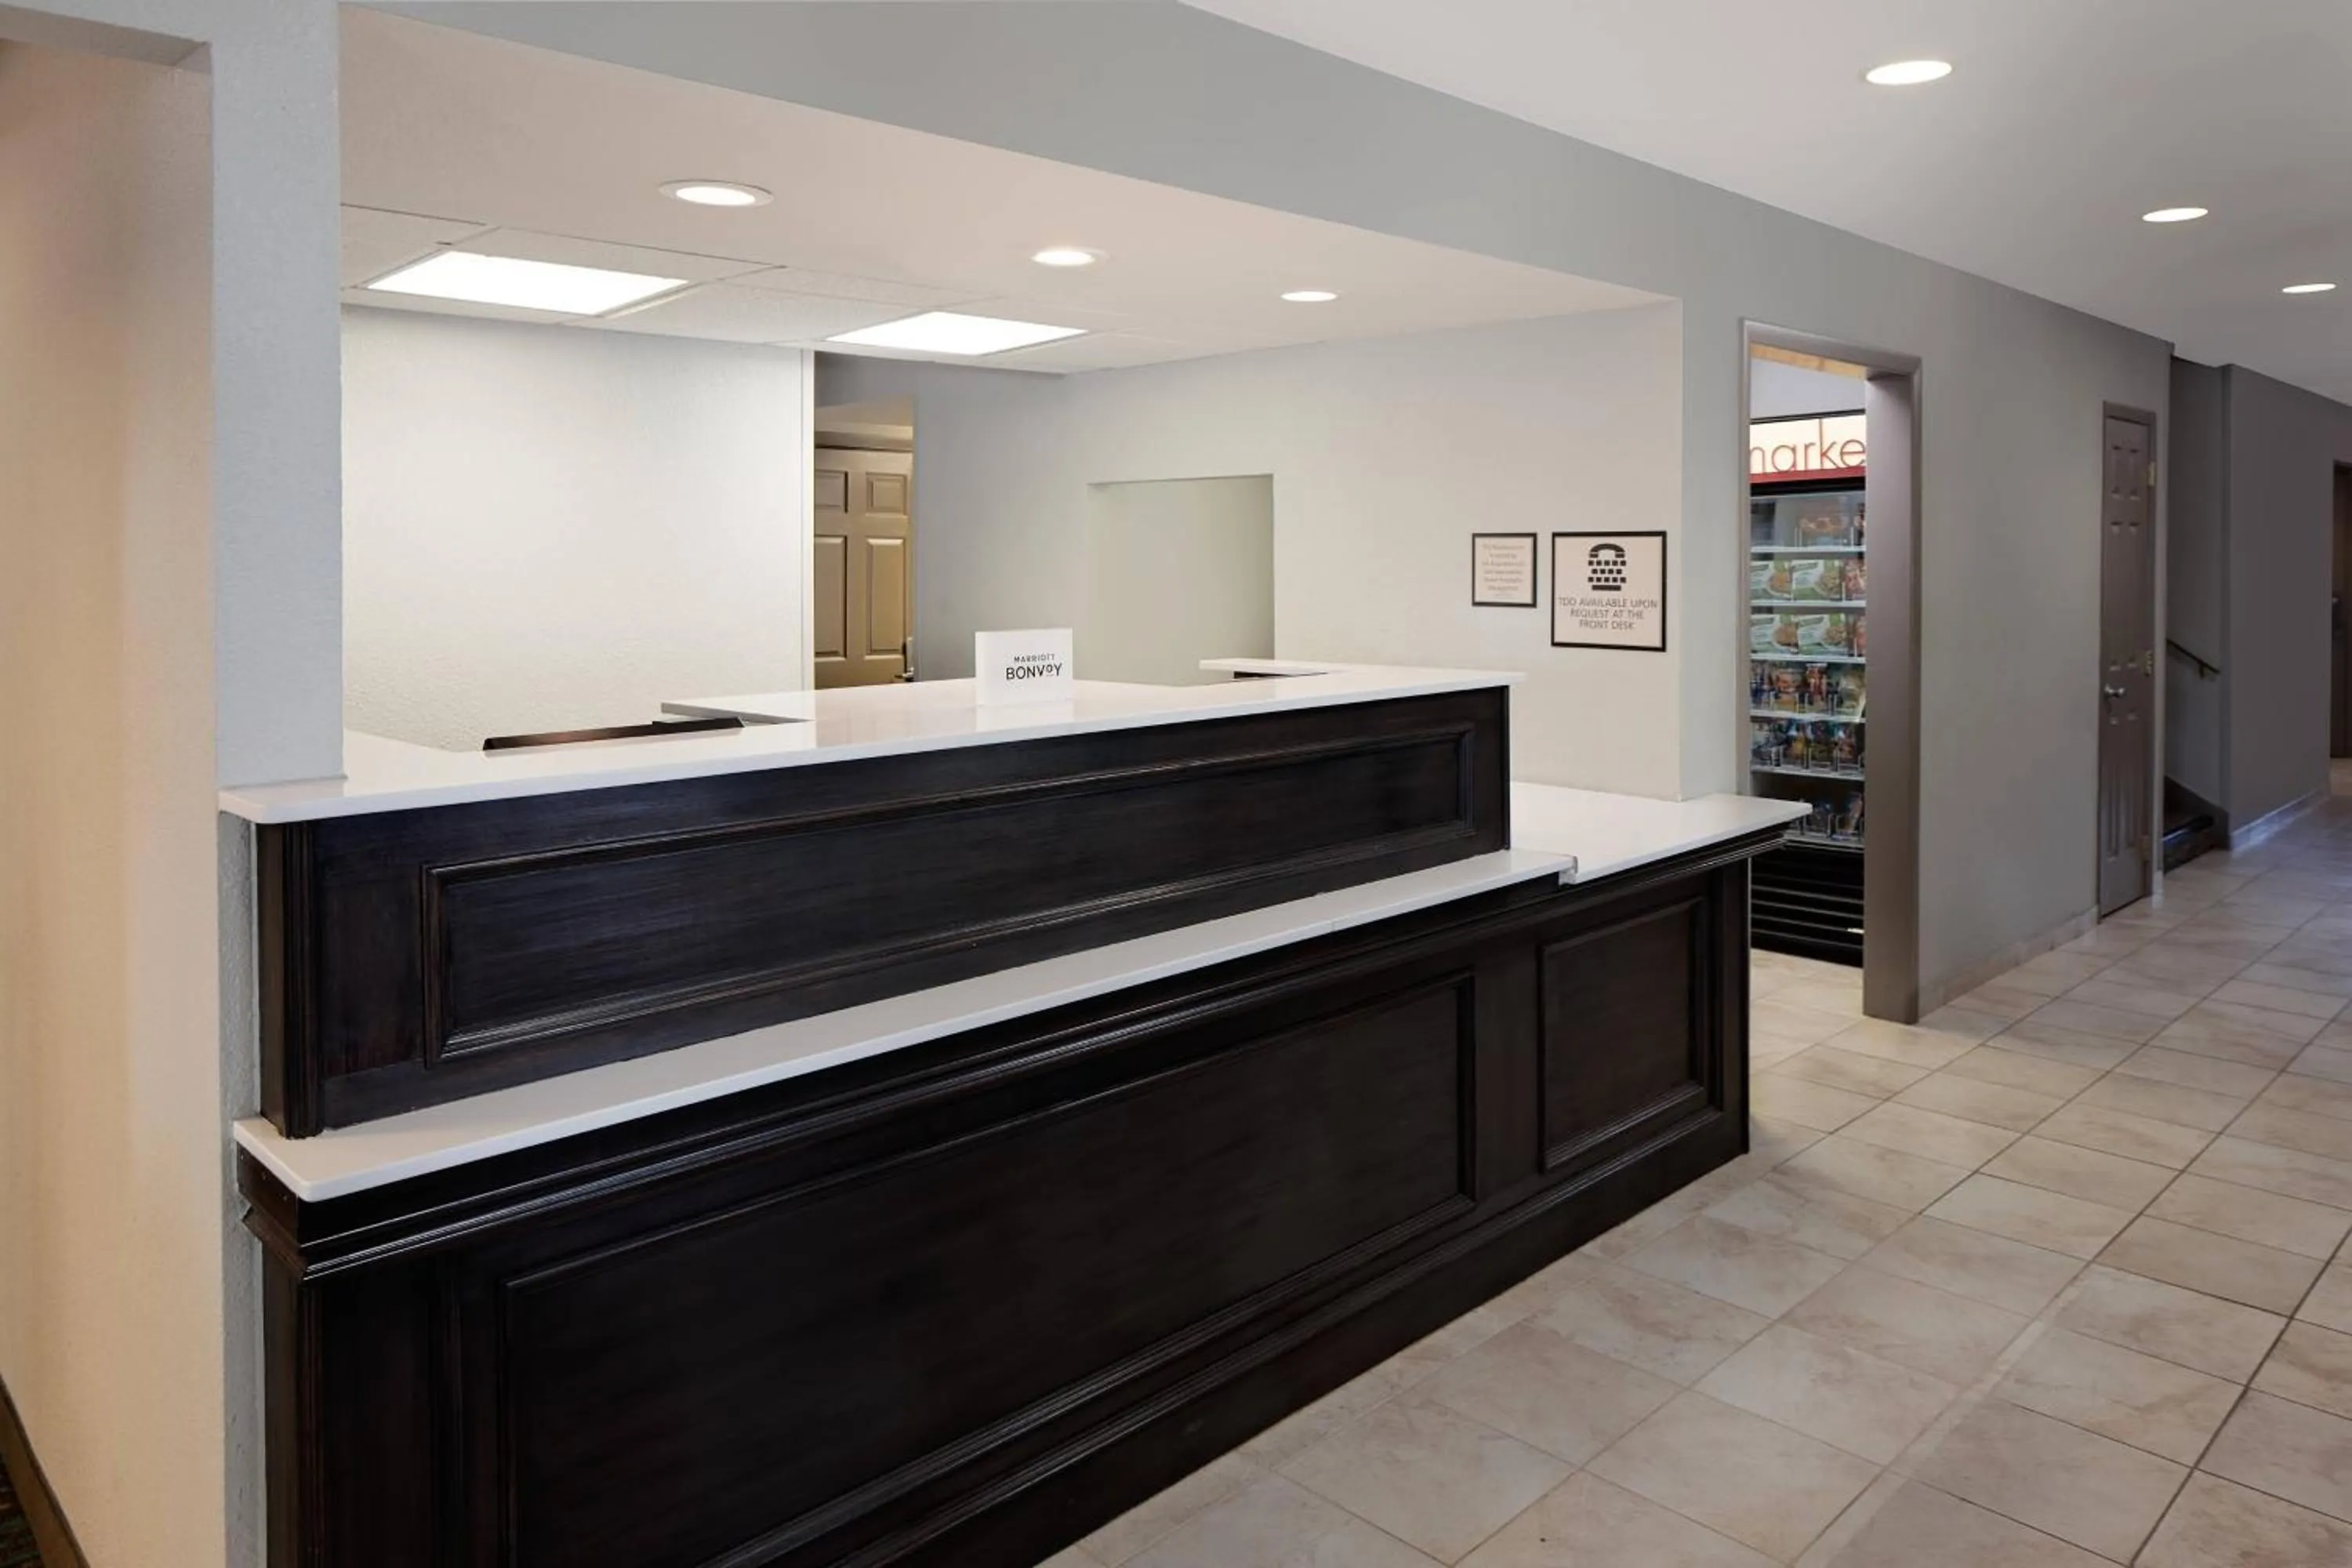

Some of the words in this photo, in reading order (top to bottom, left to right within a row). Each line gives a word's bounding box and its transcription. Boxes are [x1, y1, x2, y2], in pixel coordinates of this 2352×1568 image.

[1579, 597, 1628, 608] AVAILABLE
[1631, 599, 1657, 608] UPON
[1570, 608, 1609, 618] REQUEST
[1613, 609, 1624, 618] AT
[1628, 610, 1644, 620] THE
[1580, 619, 1609, 629] FRONT
[1611, 621, 1635, 630] DESK
[1014, 654, 1054, 662] MARRIOTT
